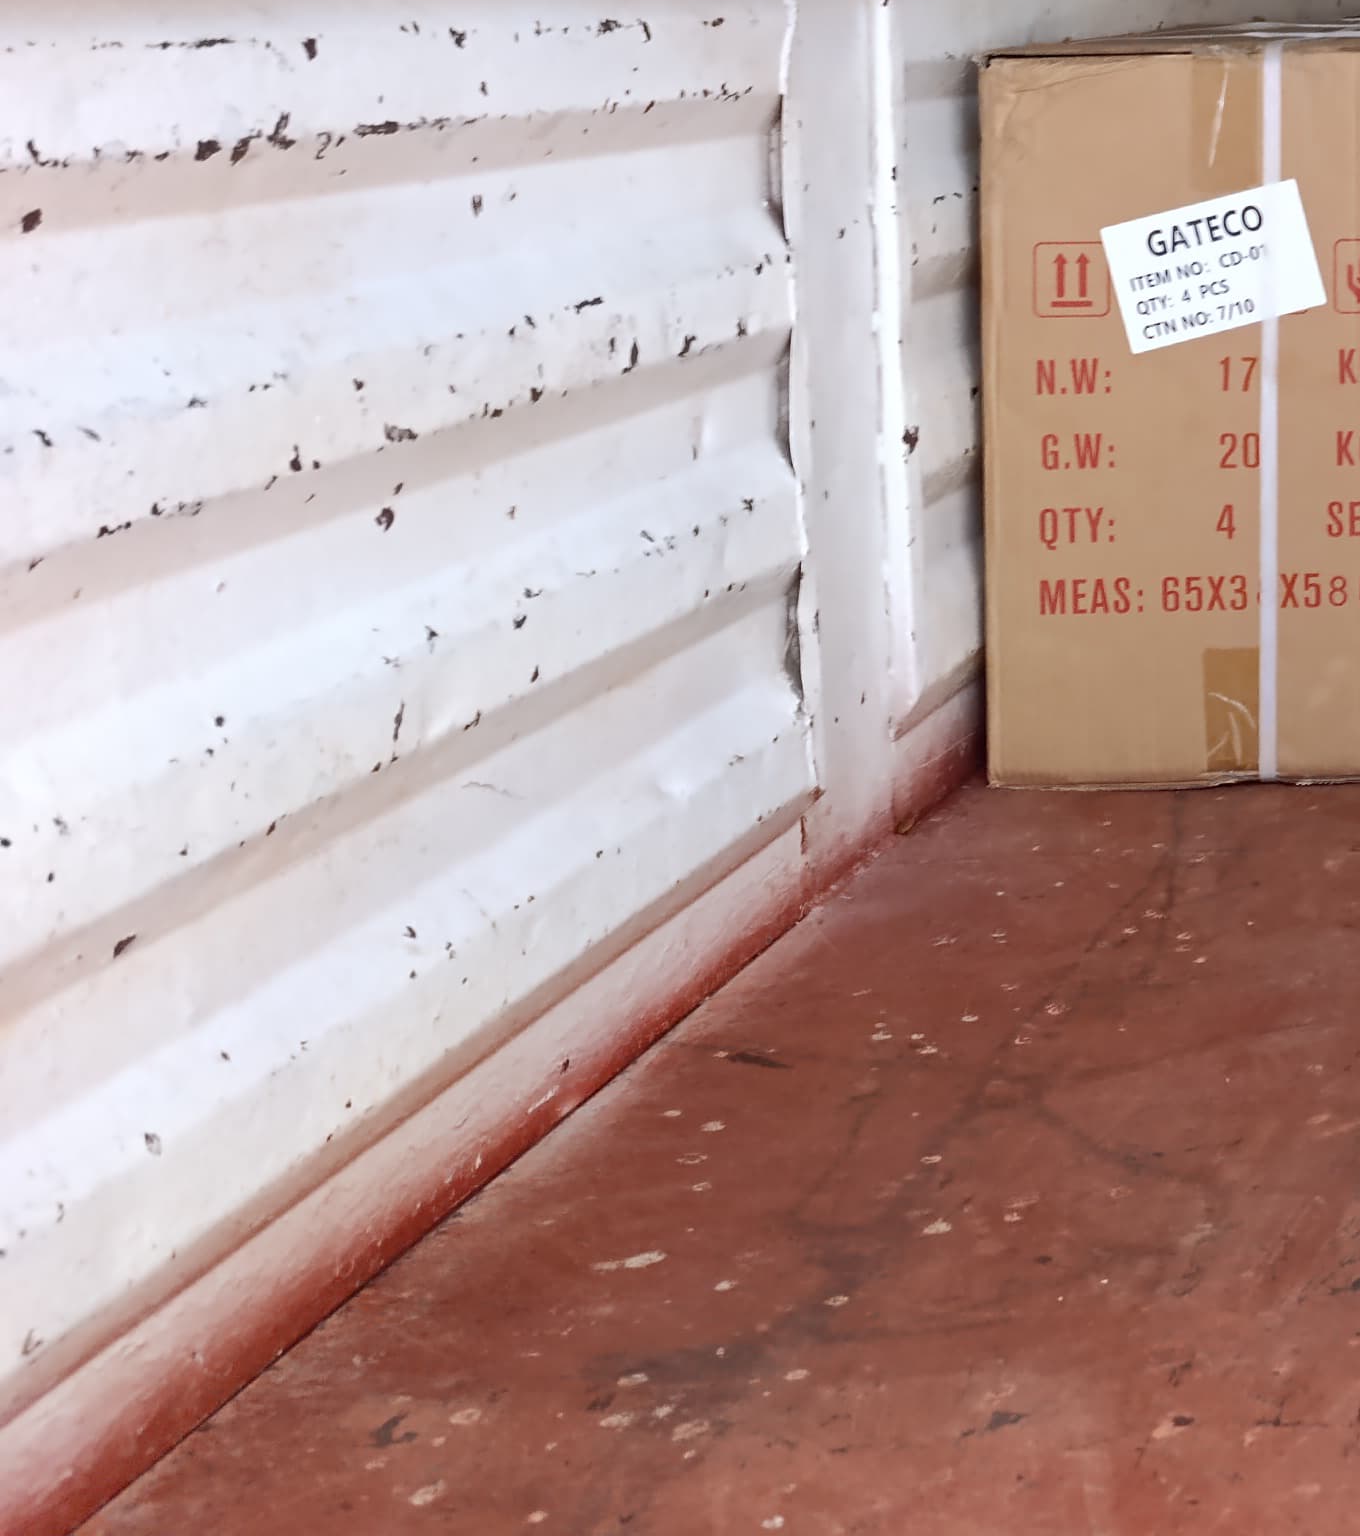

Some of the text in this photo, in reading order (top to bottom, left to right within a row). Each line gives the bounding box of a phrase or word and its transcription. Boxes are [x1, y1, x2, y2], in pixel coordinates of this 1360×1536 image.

[1147, 205, 1263, 256] GATECO
[1130, 270, 1171, 292] ITEM
[1177, 261, 1210, 279] NO:
[1136, 279, 1230, 316] QTY: 4 PCS
[1142, 298, 1255, 339] CTN NO: 7/10
[1037, 358, 1111, 395] N.W:
[1220, 357, 1258, 392] 17
[1042, 432, 1115, 470] G.W:
[1219, 432, 1260, 469] 20
[1040, 507, 1115, 551] QTY:
[1216, 504, 1235, 539] 4
[1040, 577, 1143, 615] MEAS:
